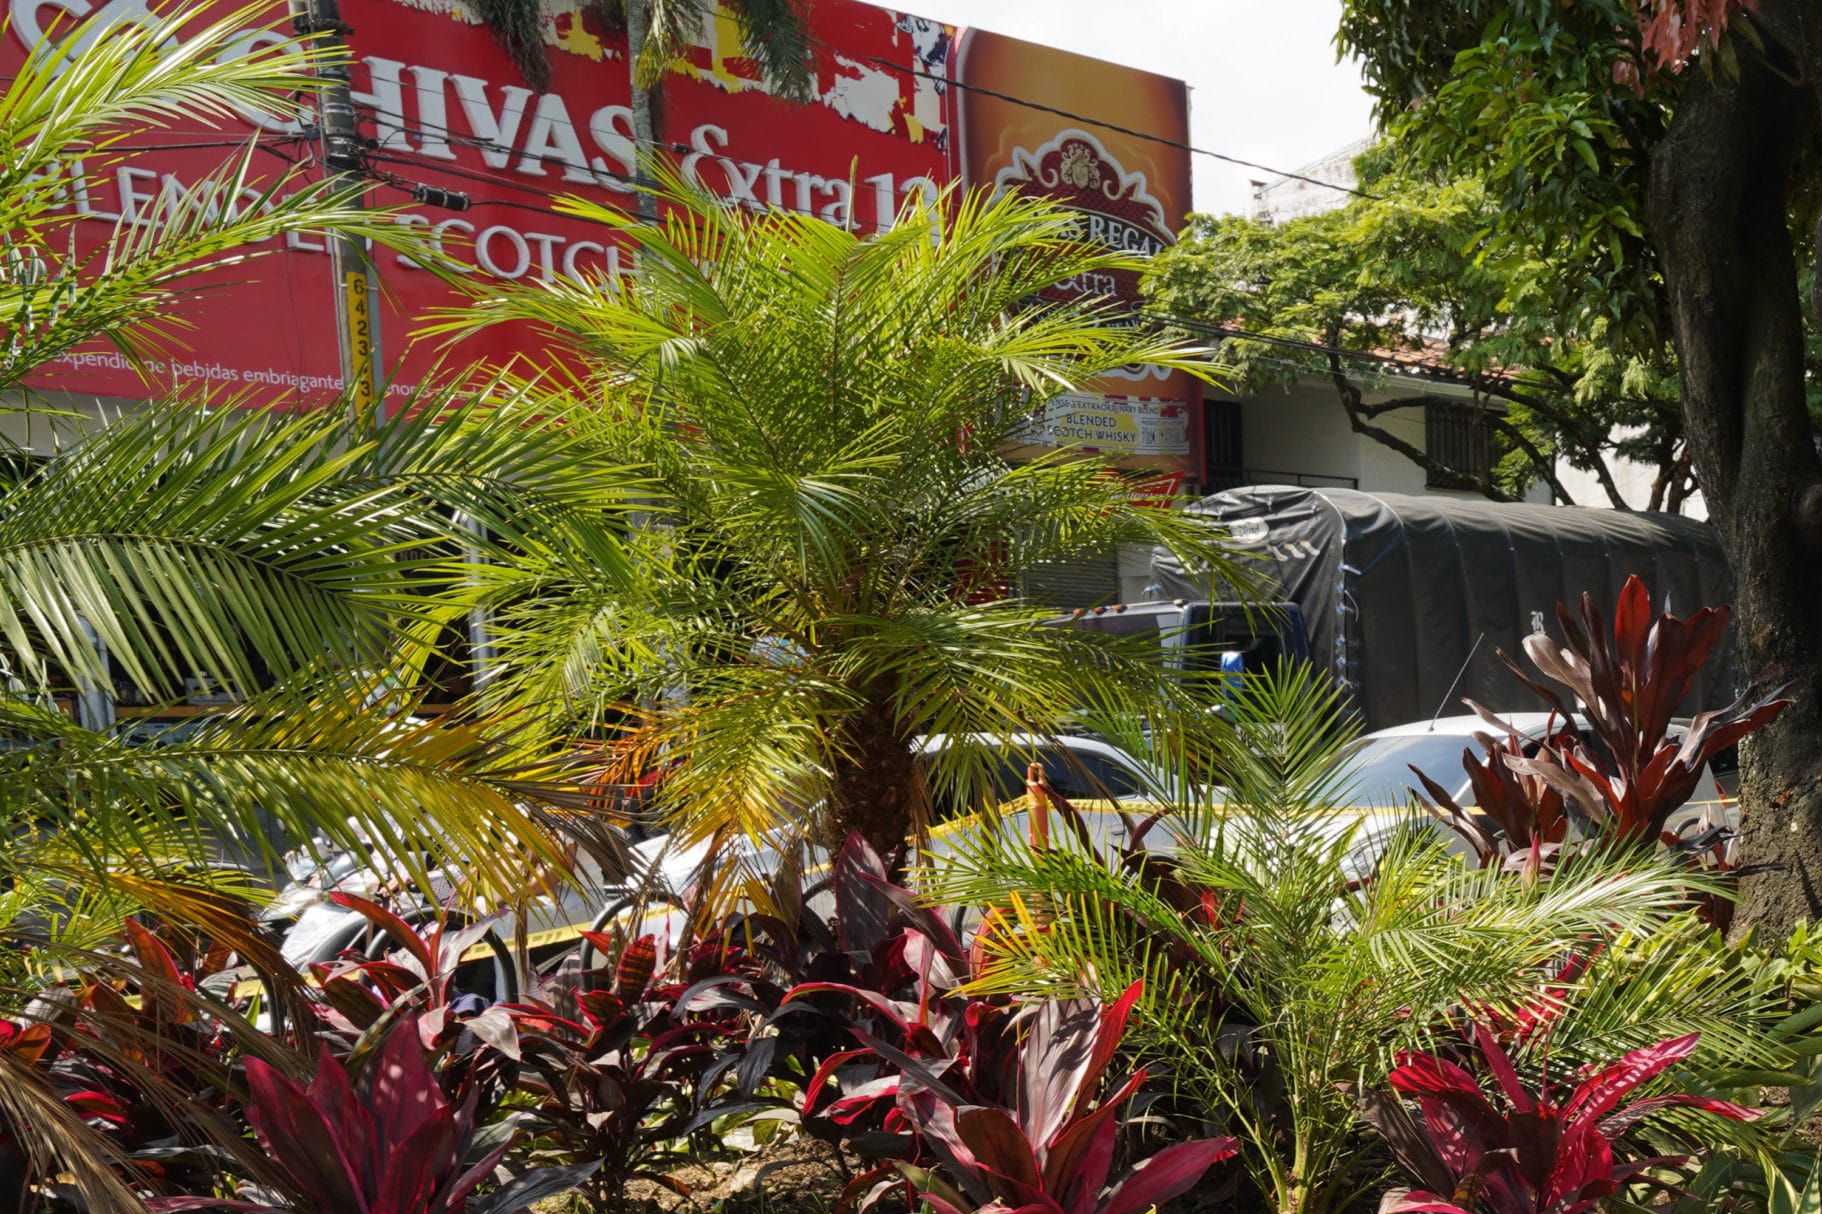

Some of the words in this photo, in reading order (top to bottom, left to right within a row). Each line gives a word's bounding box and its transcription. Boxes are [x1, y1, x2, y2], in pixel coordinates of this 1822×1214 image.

[171, 358, 239, 382] bebidas
[243, 368, 345, 394] embriagante
[1066, 413, 1117, 428] BLENDED
[1095, 427, 1136, 443] WHISKY
